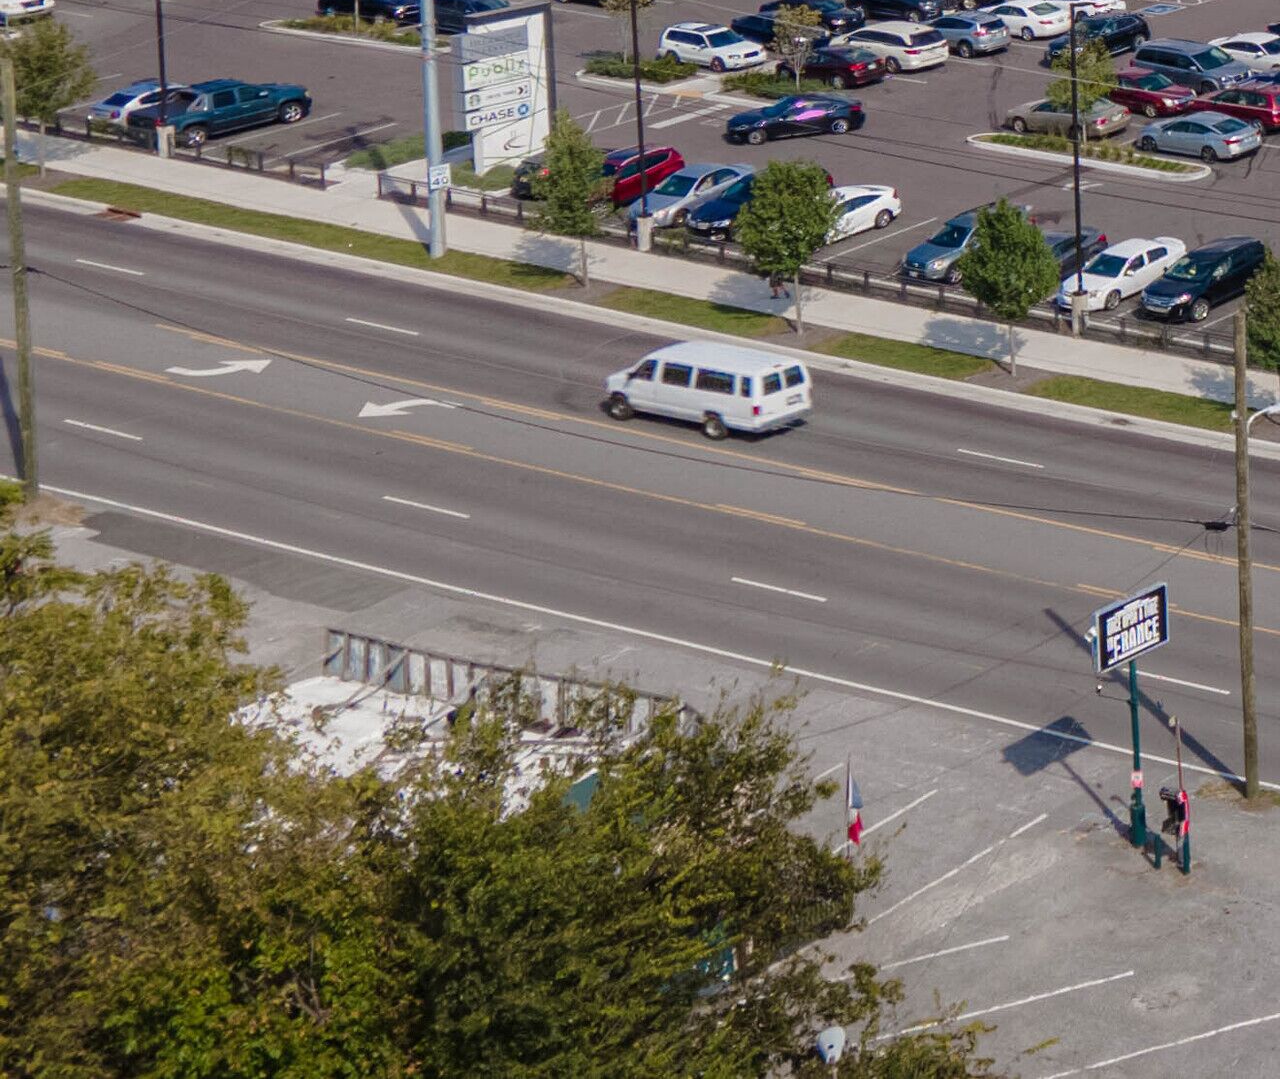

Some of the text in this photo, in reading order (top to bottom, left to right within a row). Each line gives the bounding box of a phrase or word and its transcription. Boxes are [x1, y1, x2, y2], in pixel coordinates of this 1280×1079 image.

[469, 106, 515, 126] CHASE
[432, 176, 449, 186] 40
[1112, 615, 1160, 660] FRANCE
